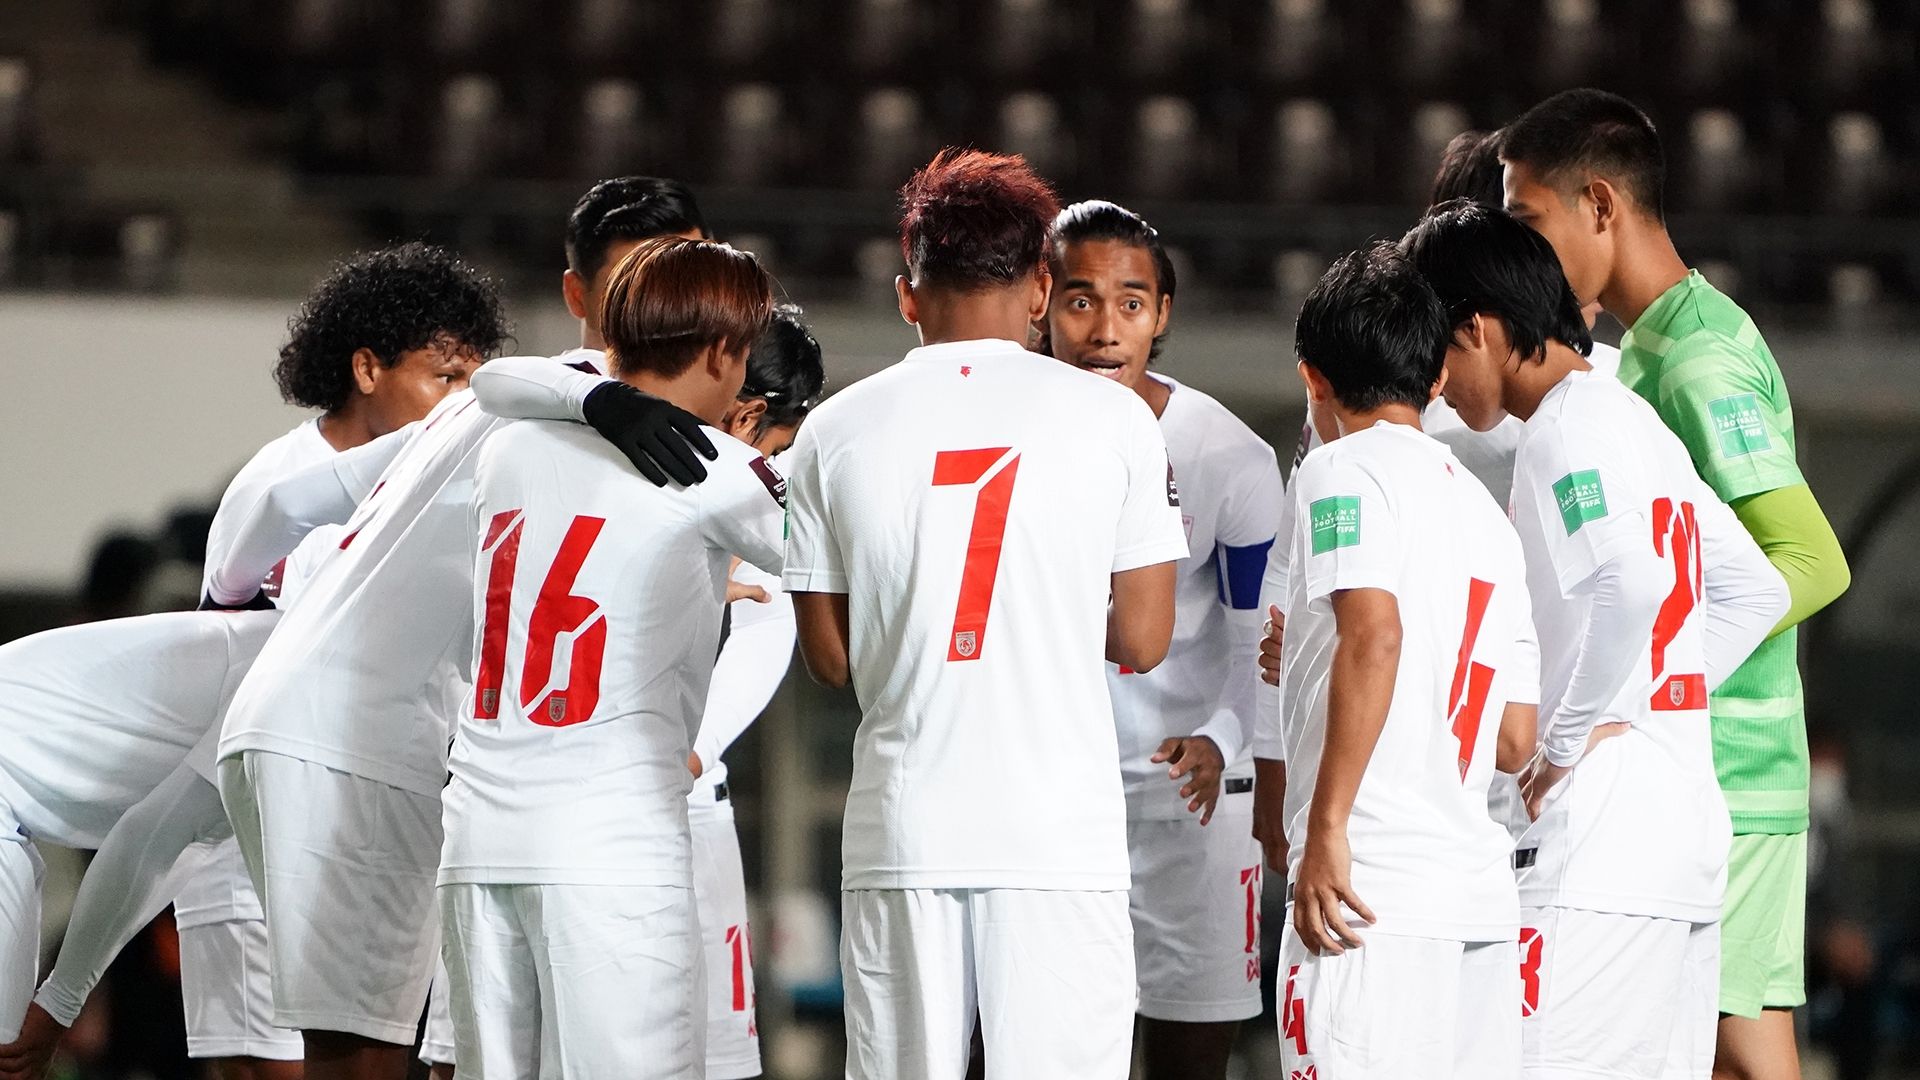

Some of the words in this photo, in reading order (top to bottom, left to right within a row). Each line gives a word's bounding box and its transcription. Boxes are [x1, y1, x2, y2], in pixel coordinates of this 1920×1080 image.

[1716, 409, 1758, 423] LIVING
[1559, 483, 1598, 502] LIVING
[1580, 498, 1601, 509] FIFA
[1314, 508, 1356, 523] LIVING
[1336, 526, 1356, 534] FIFA
[932, 447, 1021, 662] 7
[473, 508, 607, 727] 16
[1447, 576, 1496, 788] 4
[1282, 965, 1308, 1056] 4
